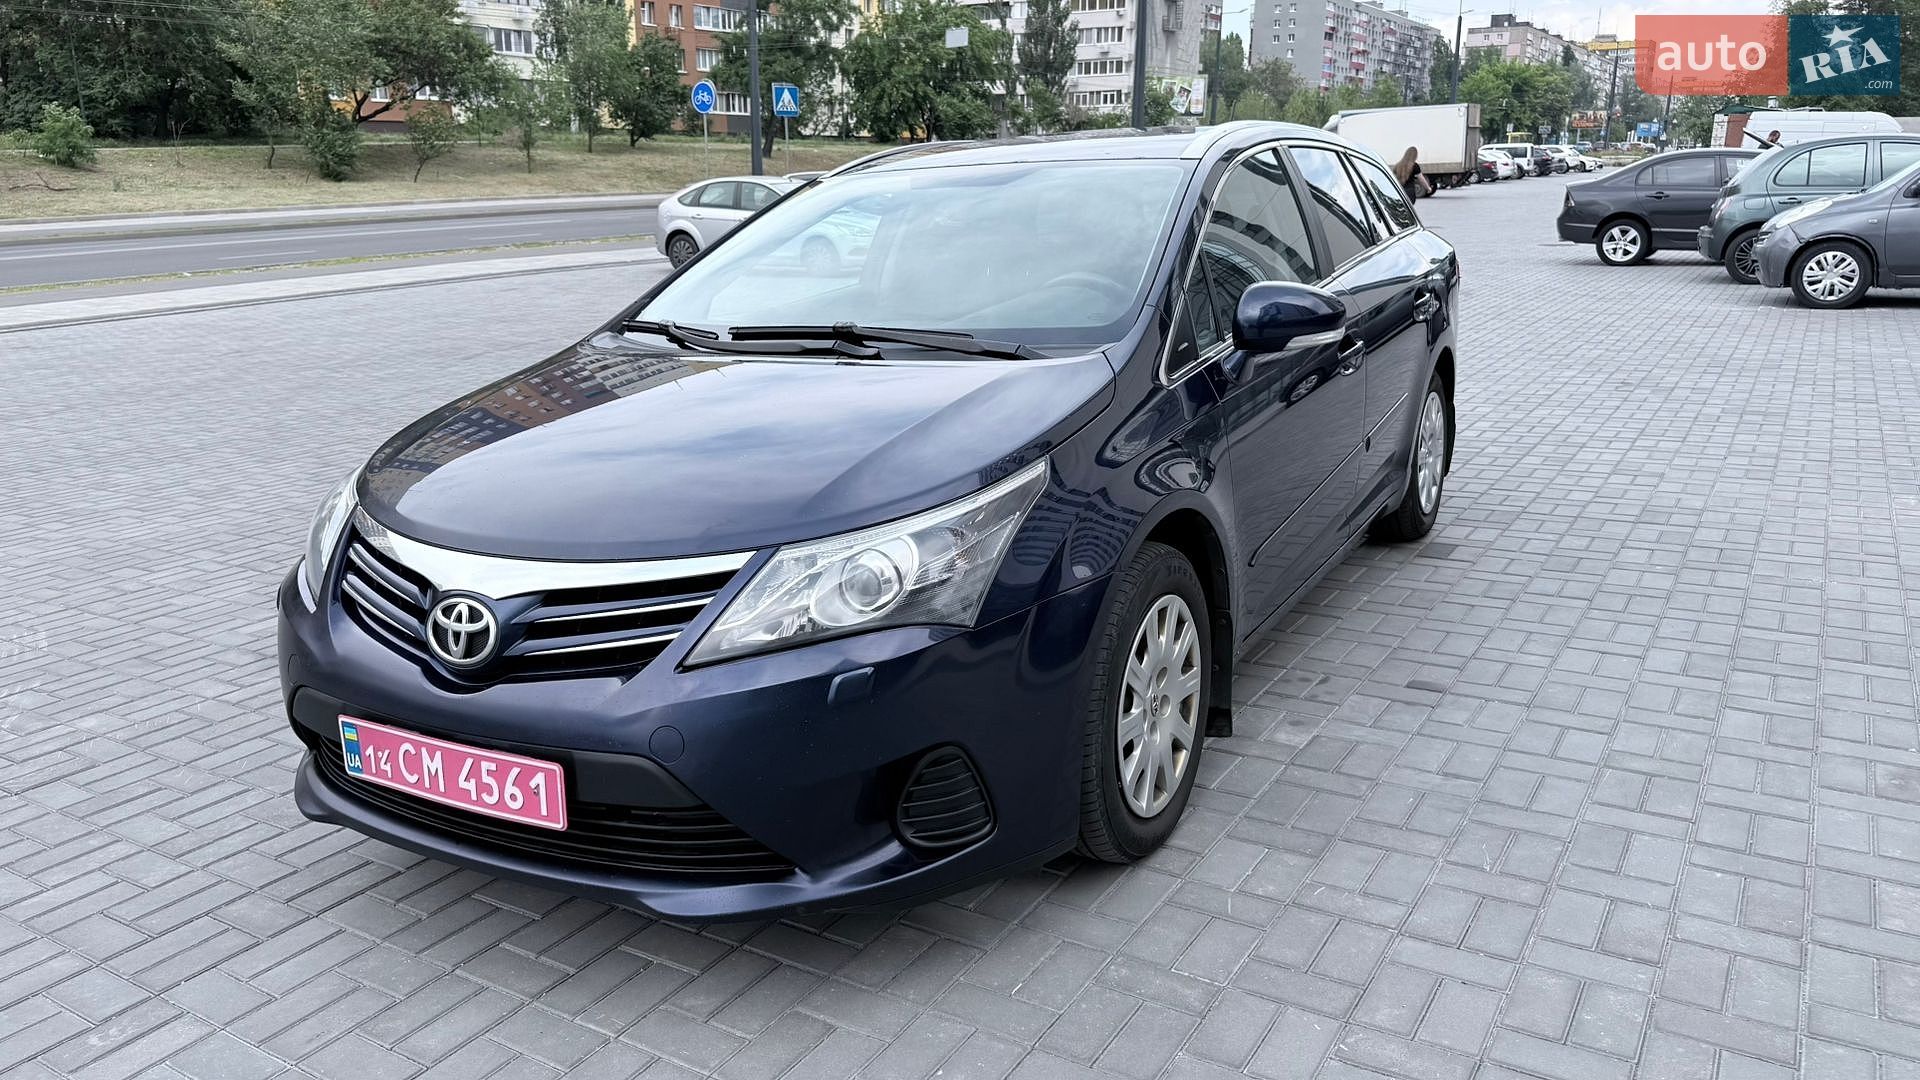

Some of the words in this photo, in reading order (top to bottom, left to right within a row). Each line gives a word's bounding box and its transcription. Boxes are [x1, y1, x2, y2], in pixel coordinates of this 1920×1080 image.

[347, 752, 362, 769] UA
[365, 745, 392, 778] 14
[398, 742, 446, 793] CM
[458, 757, 548, 817] 4561
